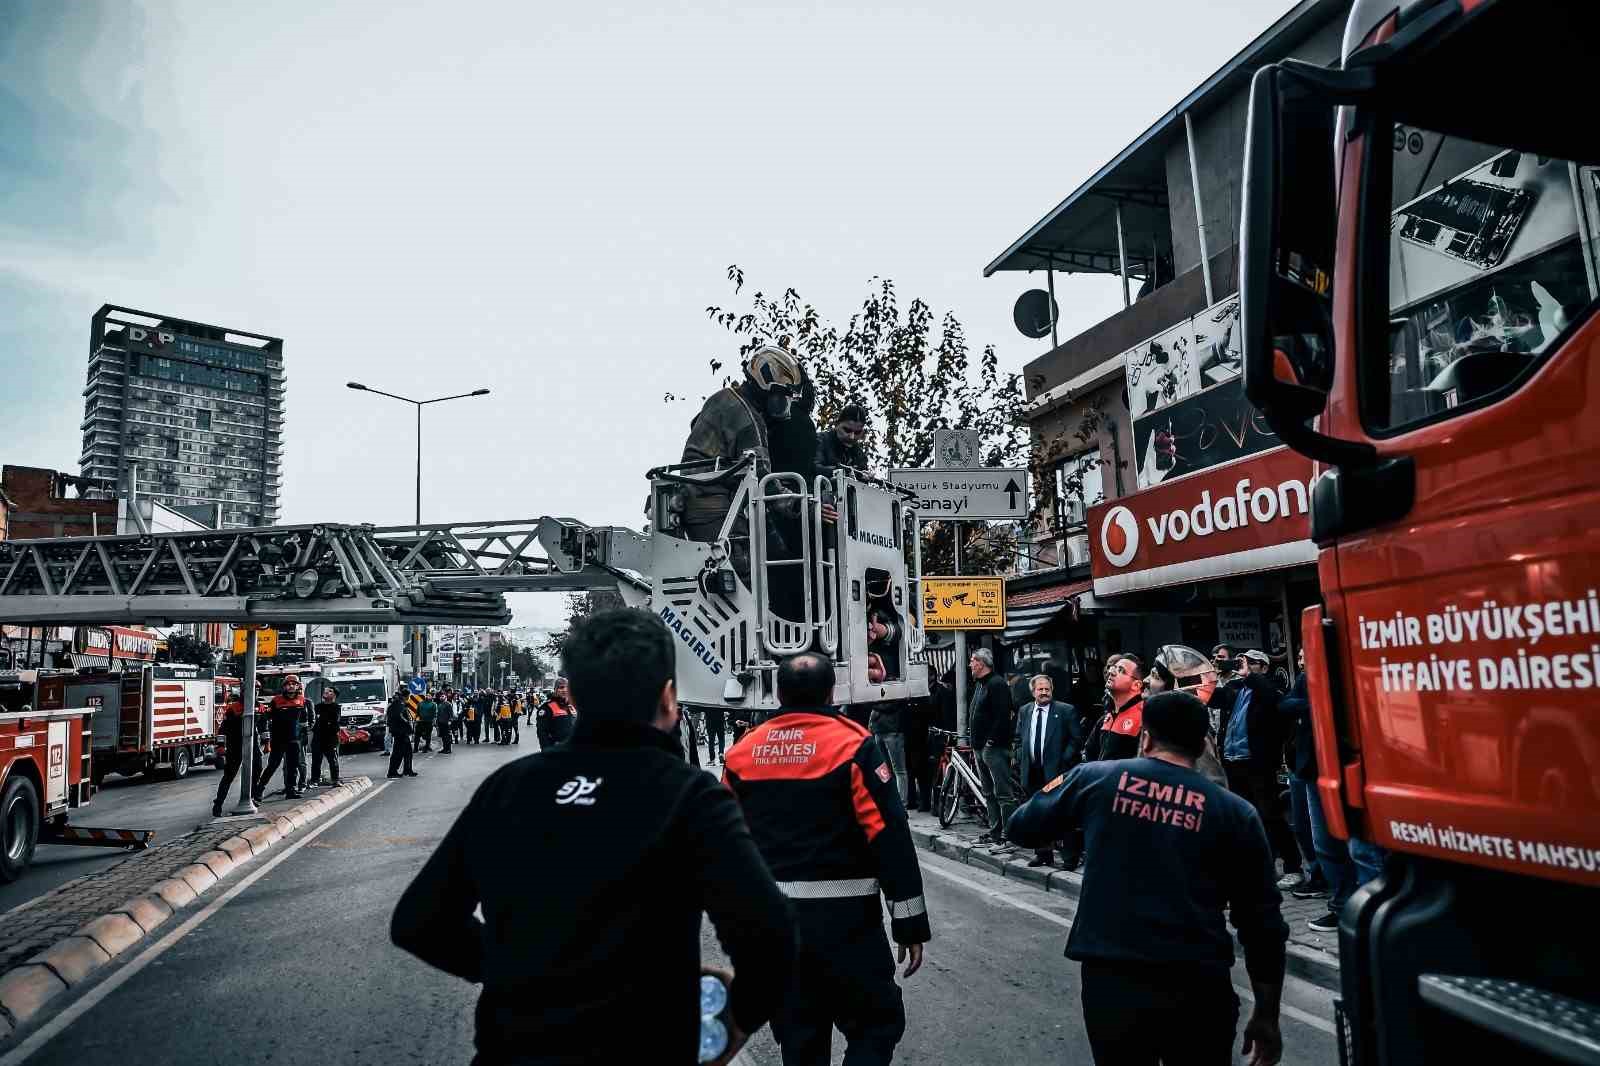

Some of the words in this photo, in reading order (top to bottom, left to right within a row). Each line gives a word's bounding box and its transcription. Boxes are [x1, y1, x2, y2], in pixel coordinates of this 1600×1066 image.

[942, 480, 999, 493] Stadyumu
[910, 495, 968, 514] Sanayi
[1147, 478, 1315, 545] vodafon
[860, 530, 893, 548] MAGIRUS
[660, 606, 723, 675] MAGIRUS
[1358, 610, 1422, 650] İZMİR
[1380, 652, 1473, 692] İTFAİYE
[87, 697, 102, 706] 112
[752, 741, 816, 757] İTFAİYESİ
[767, 728, 804, 742] İZMİR
[51, 746, 62, 765] 112
[1118, 771, 1206, 811] İZMİR
[1112, 793, 1203, 833] İTFAİYESİ
[1389, 820, 1437, 847] RESMİ
[1438, 825, 1517, 860] HİZMETE
